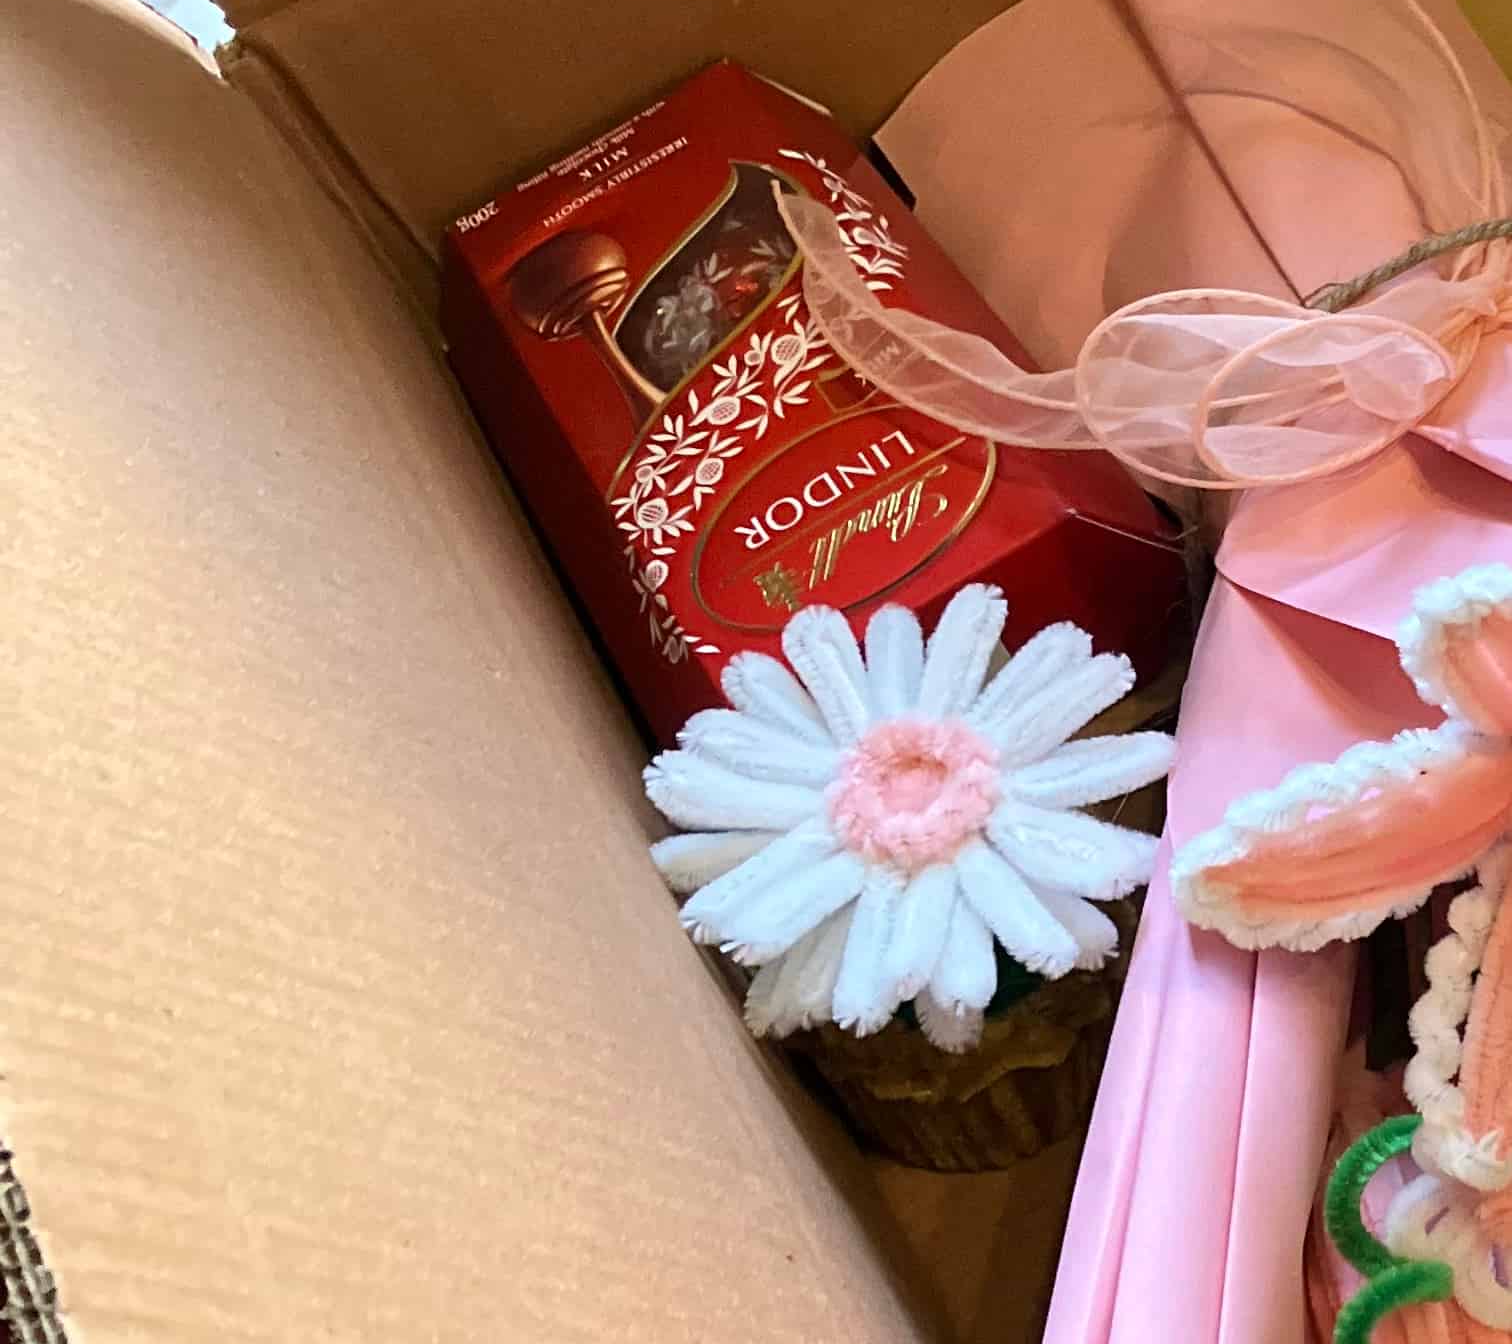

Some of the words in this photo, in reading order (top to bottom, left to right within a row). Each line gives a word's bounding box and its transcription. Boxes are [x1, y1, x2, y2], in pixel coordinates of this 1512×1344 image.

[579, 146, 628, 181] MILK
[607, 137, 688, 190] IRRESISTIBLY
[455, 200, 498, 233] 200g
[543, 186, 605, 228] SMOOTH
[733, 430, 914, 549] LINDOR
[809, 464, 948, 590] Lindt
